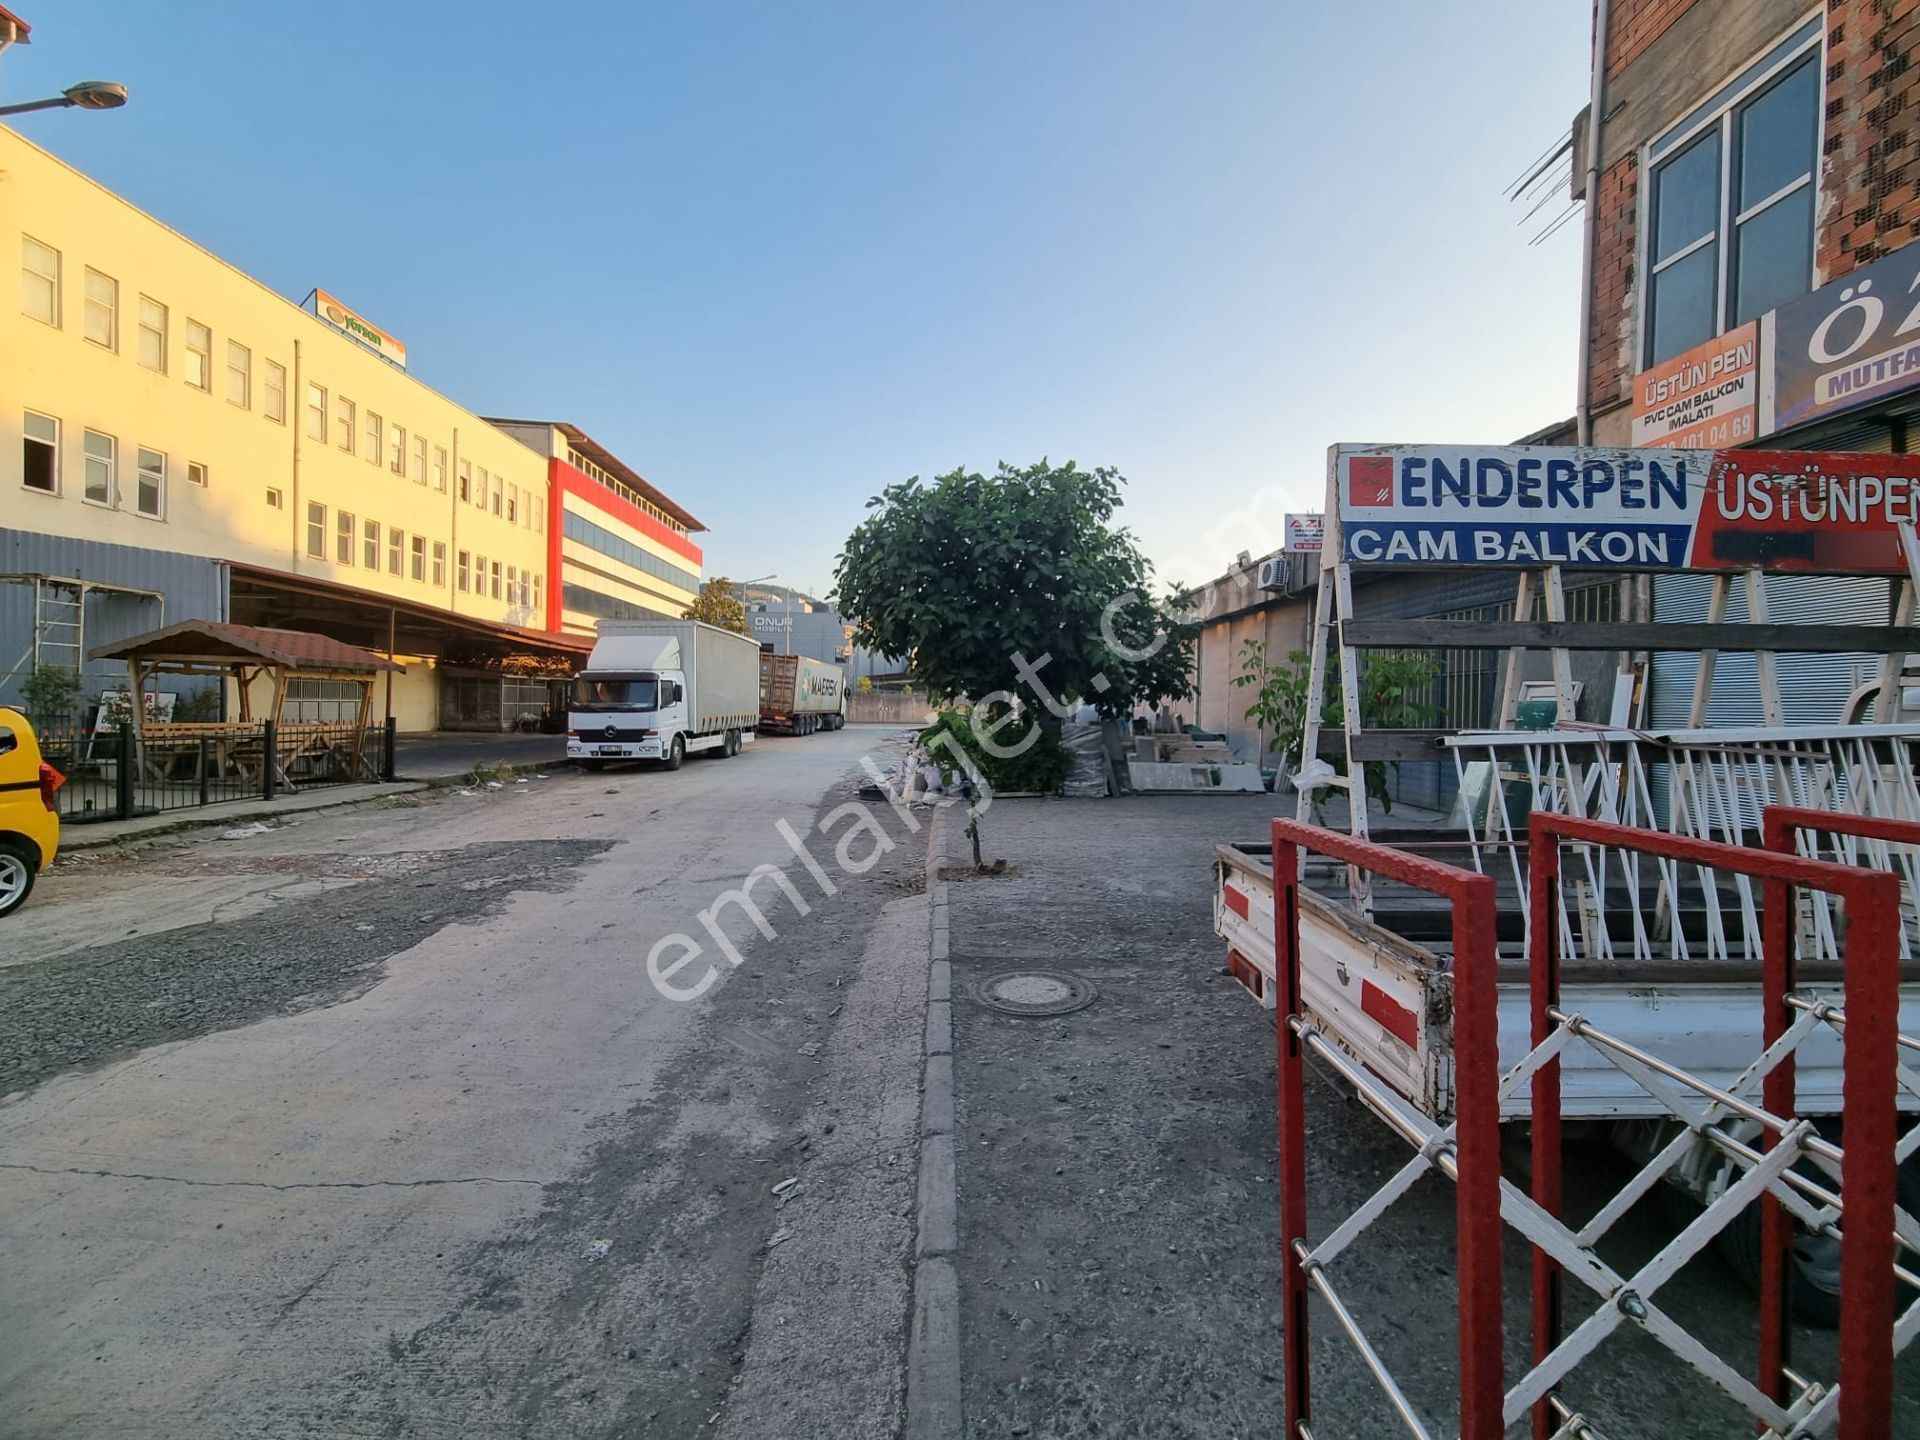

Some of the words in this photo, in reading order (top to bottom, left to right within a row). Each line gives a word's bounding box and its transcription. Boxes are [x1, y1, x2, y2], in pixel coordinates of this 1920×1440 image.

[1645, 360, 1708, 407] ÜSTÜN
[1710, 341, 1753, 381] PEN
[1644, 410, 1665, 427] PVC
[1666, 399, 1692, 418] CAM
[1693, 377, 1745, 407] BALKON
[1710, 422, 1728, 446] 04
[1732, 414, 1751, 438] 69
[1401, 457, 1688, 511] ENDERPEN
[1350, 529, 1458, 562] CAM
[1474, 530, 1670, 563] BALKON
[755, 617, 793, 626] ONUR
[811, 676, 838, 697] MAERSK
